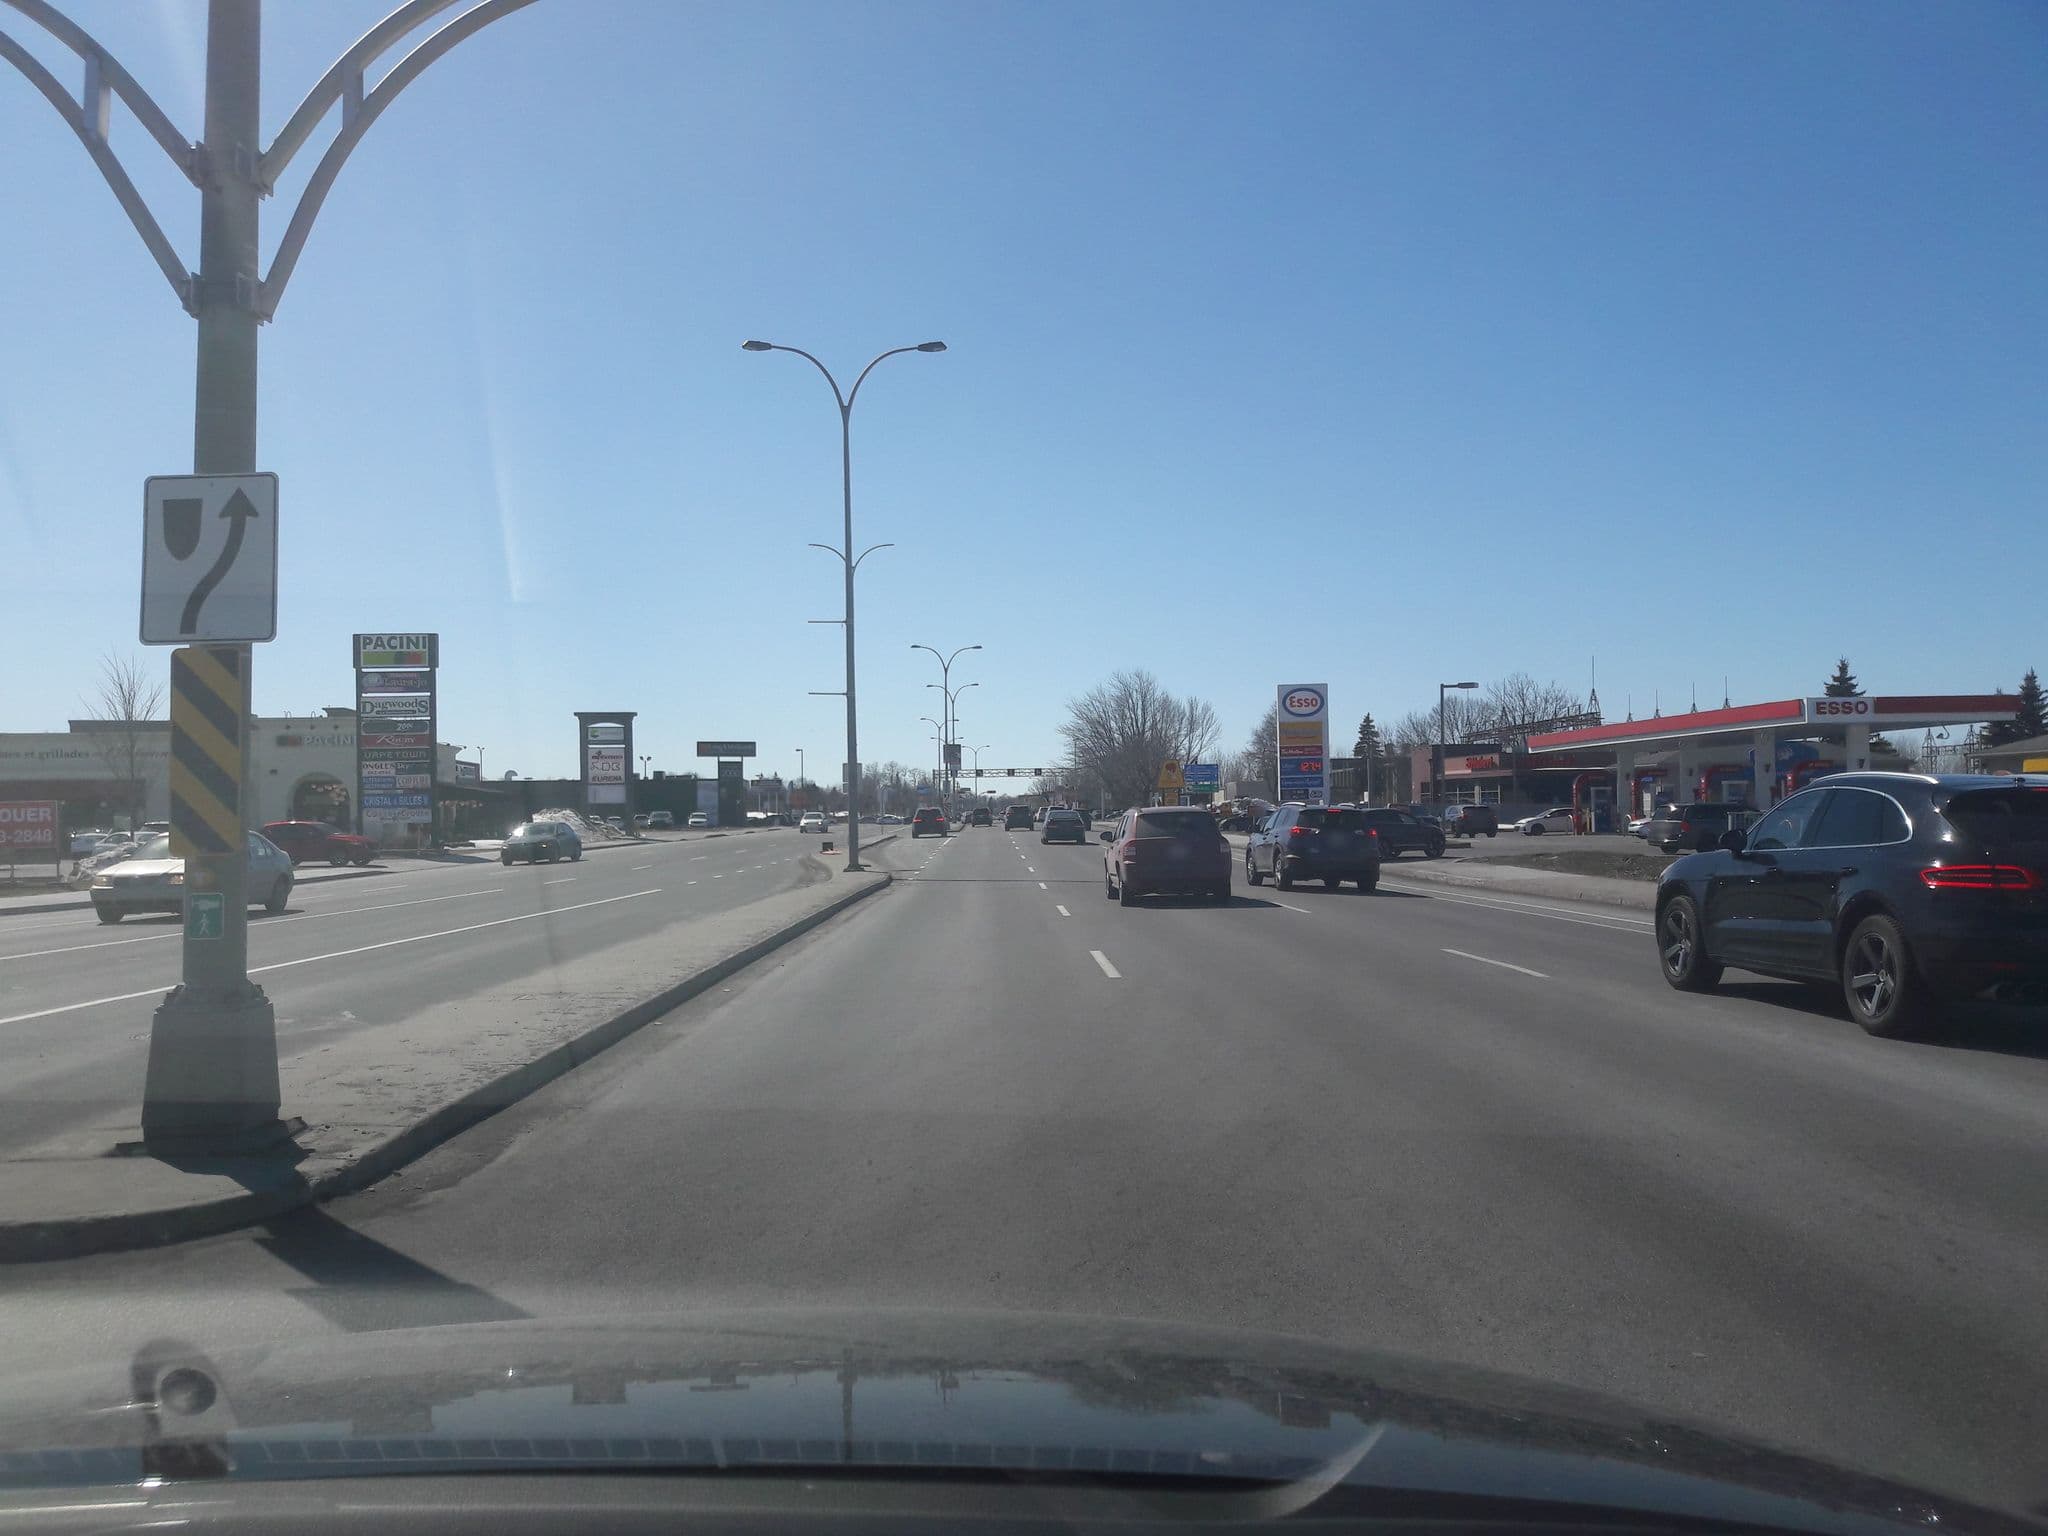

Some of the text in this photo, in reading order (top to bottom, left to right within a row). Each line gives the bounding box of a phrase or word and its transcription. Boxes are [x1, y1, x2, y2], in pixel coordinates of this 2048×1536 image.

[362, 635, 428, 650] PACINI
[1289, 695, 1319, 708] Esso
[1815, 700, 1869, 715] ESSO
